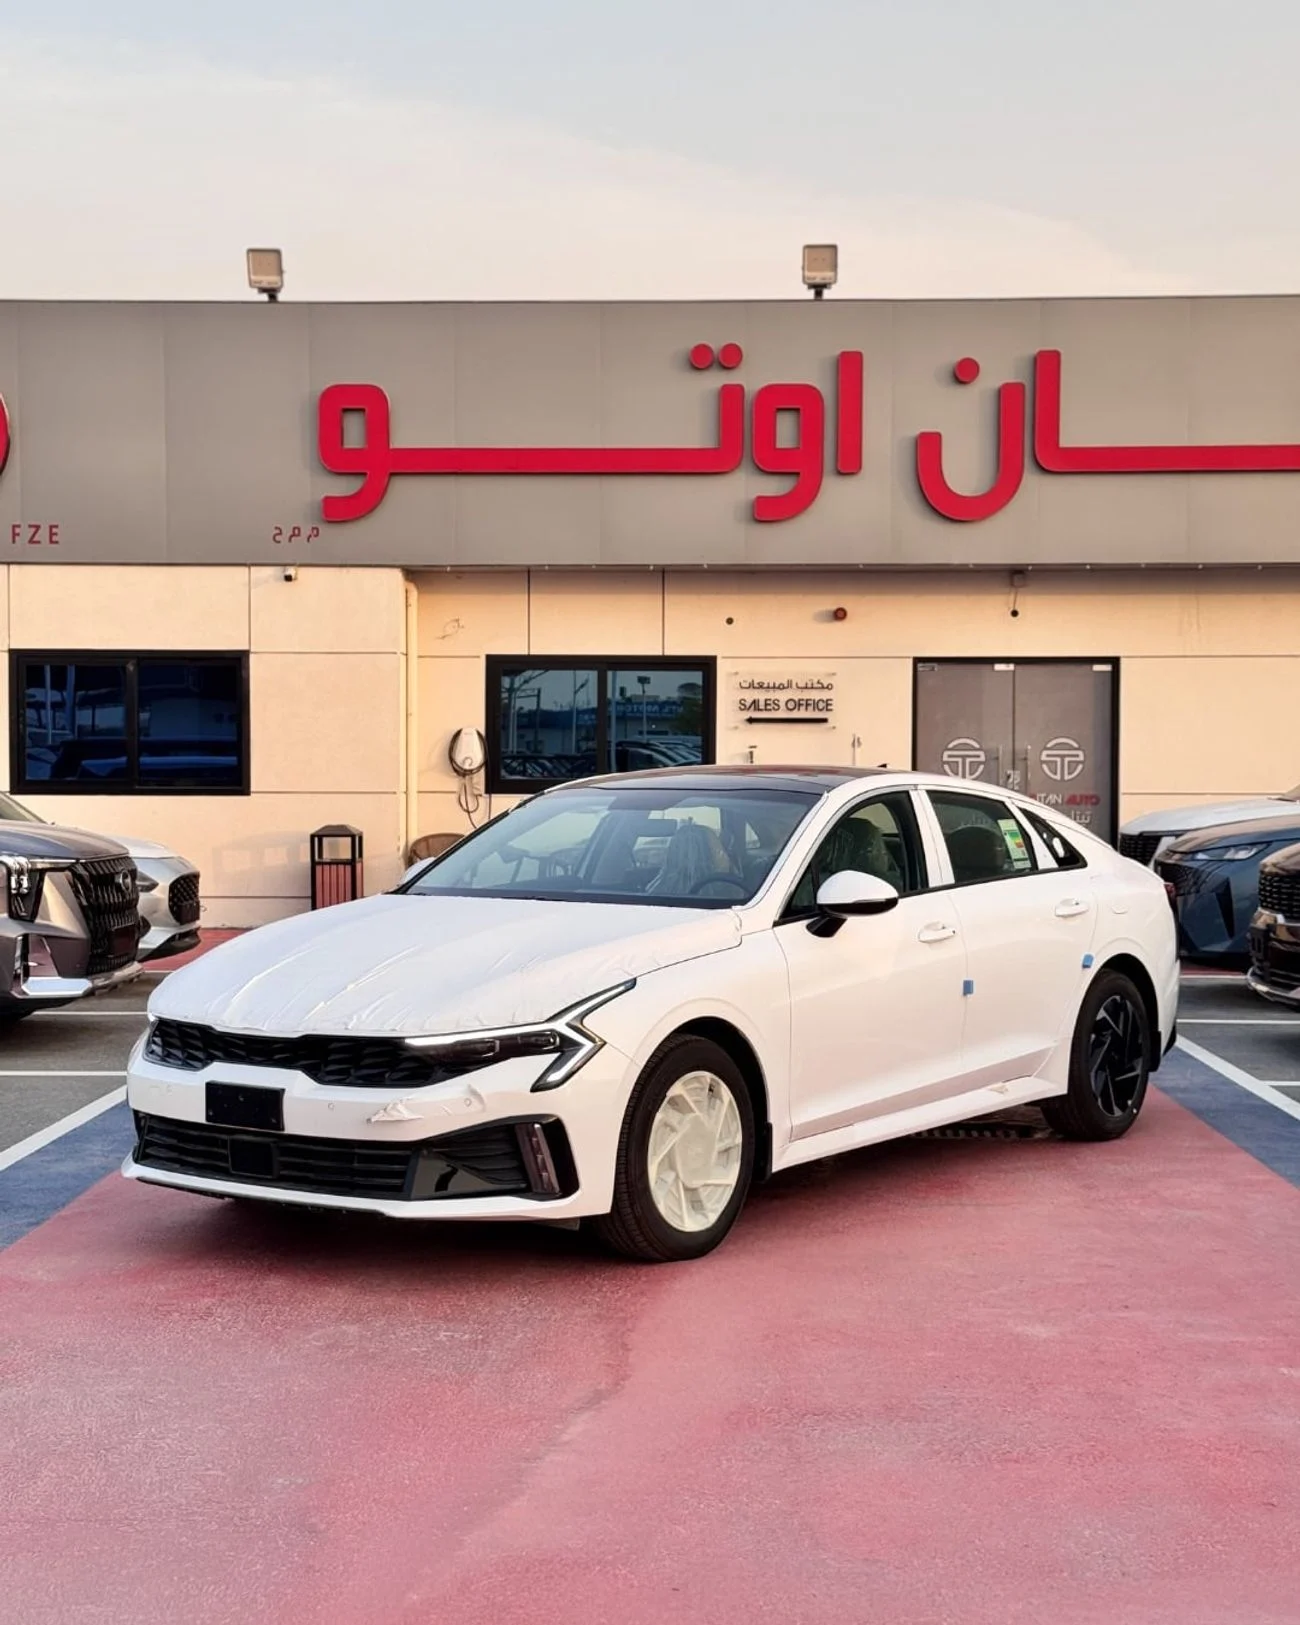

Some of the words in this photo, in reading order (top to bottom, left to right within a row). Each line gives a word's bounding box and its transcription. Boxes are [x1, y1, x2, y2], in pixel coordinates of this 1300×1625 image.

[12, 524, 59, 545] FZE
[739, 679, 793, 692] المبيعات
[795, 679, 834, 692] مكتب
[738, 698, 780, 712] SALES
[785, 698, 834, 712] OFFICE
[1065, 793, 1101, 806] AUTO
